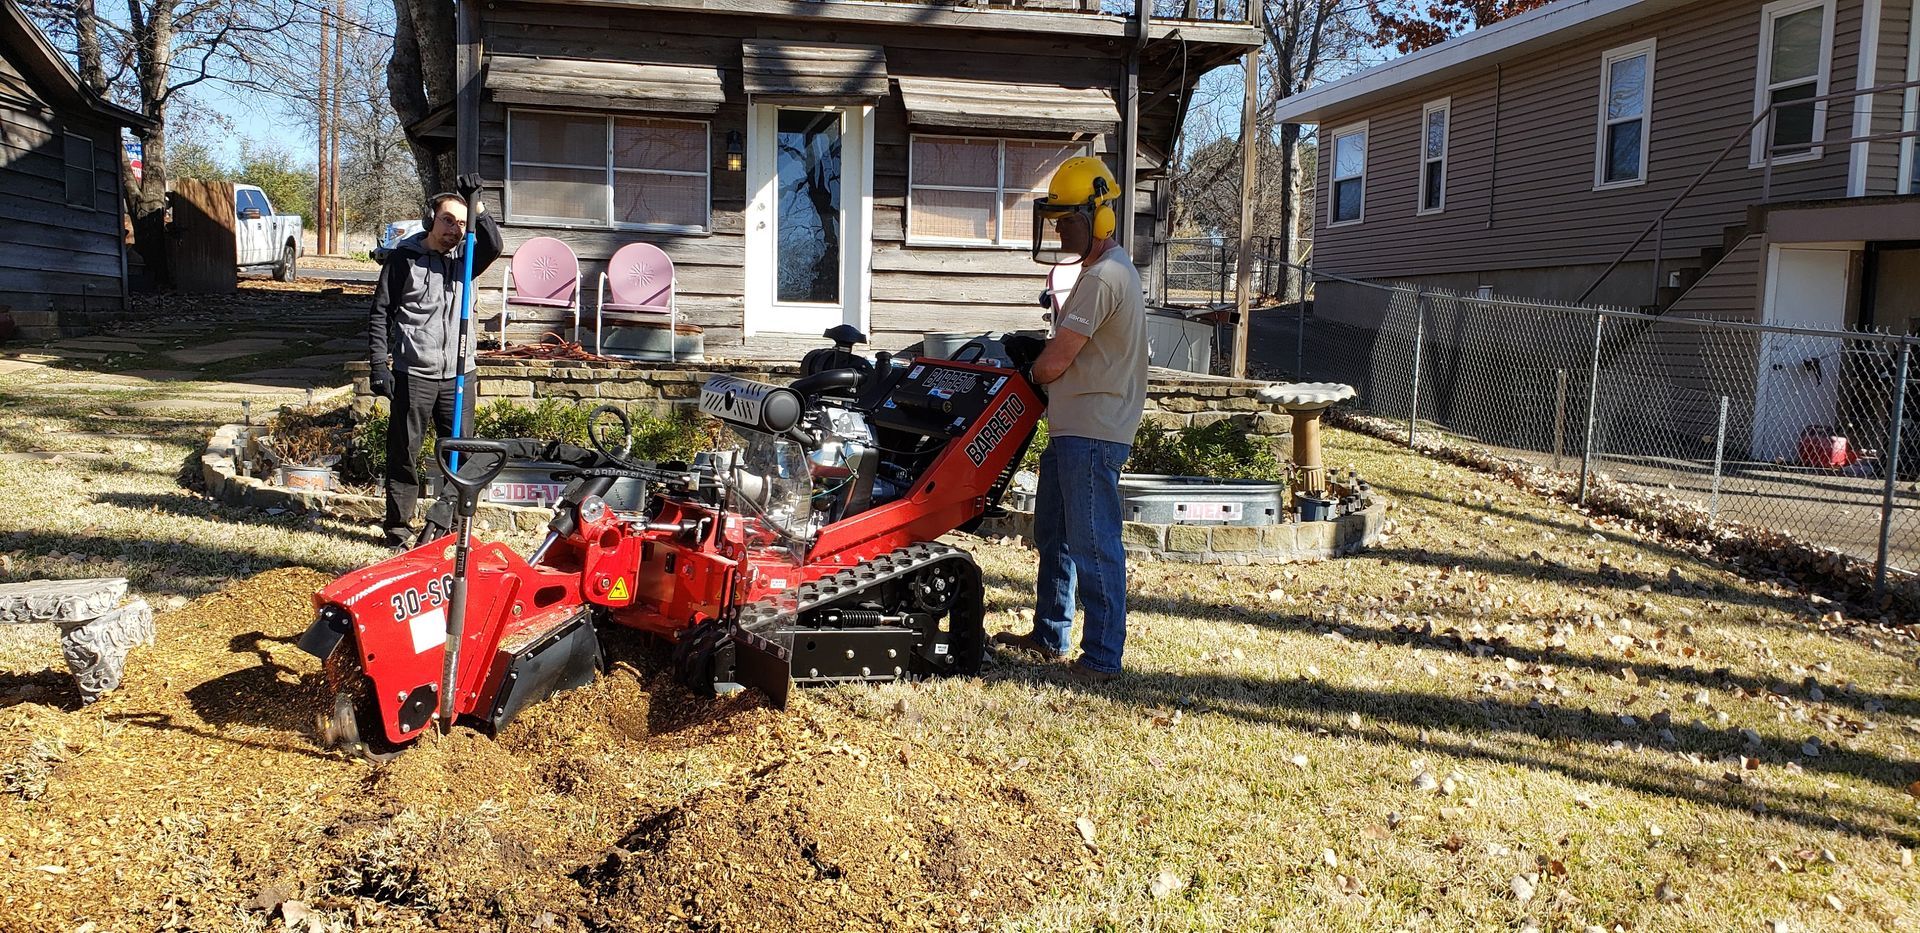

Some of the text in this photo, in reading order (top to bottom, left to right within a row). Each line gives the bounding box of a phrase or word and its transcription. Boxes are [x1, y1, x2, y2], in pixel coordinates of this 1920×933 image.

[922, 367, 980, 394] BARRETO
[964, 392, 1026, 468] BARRETO
[457, 551, 466, 573] STEEL
